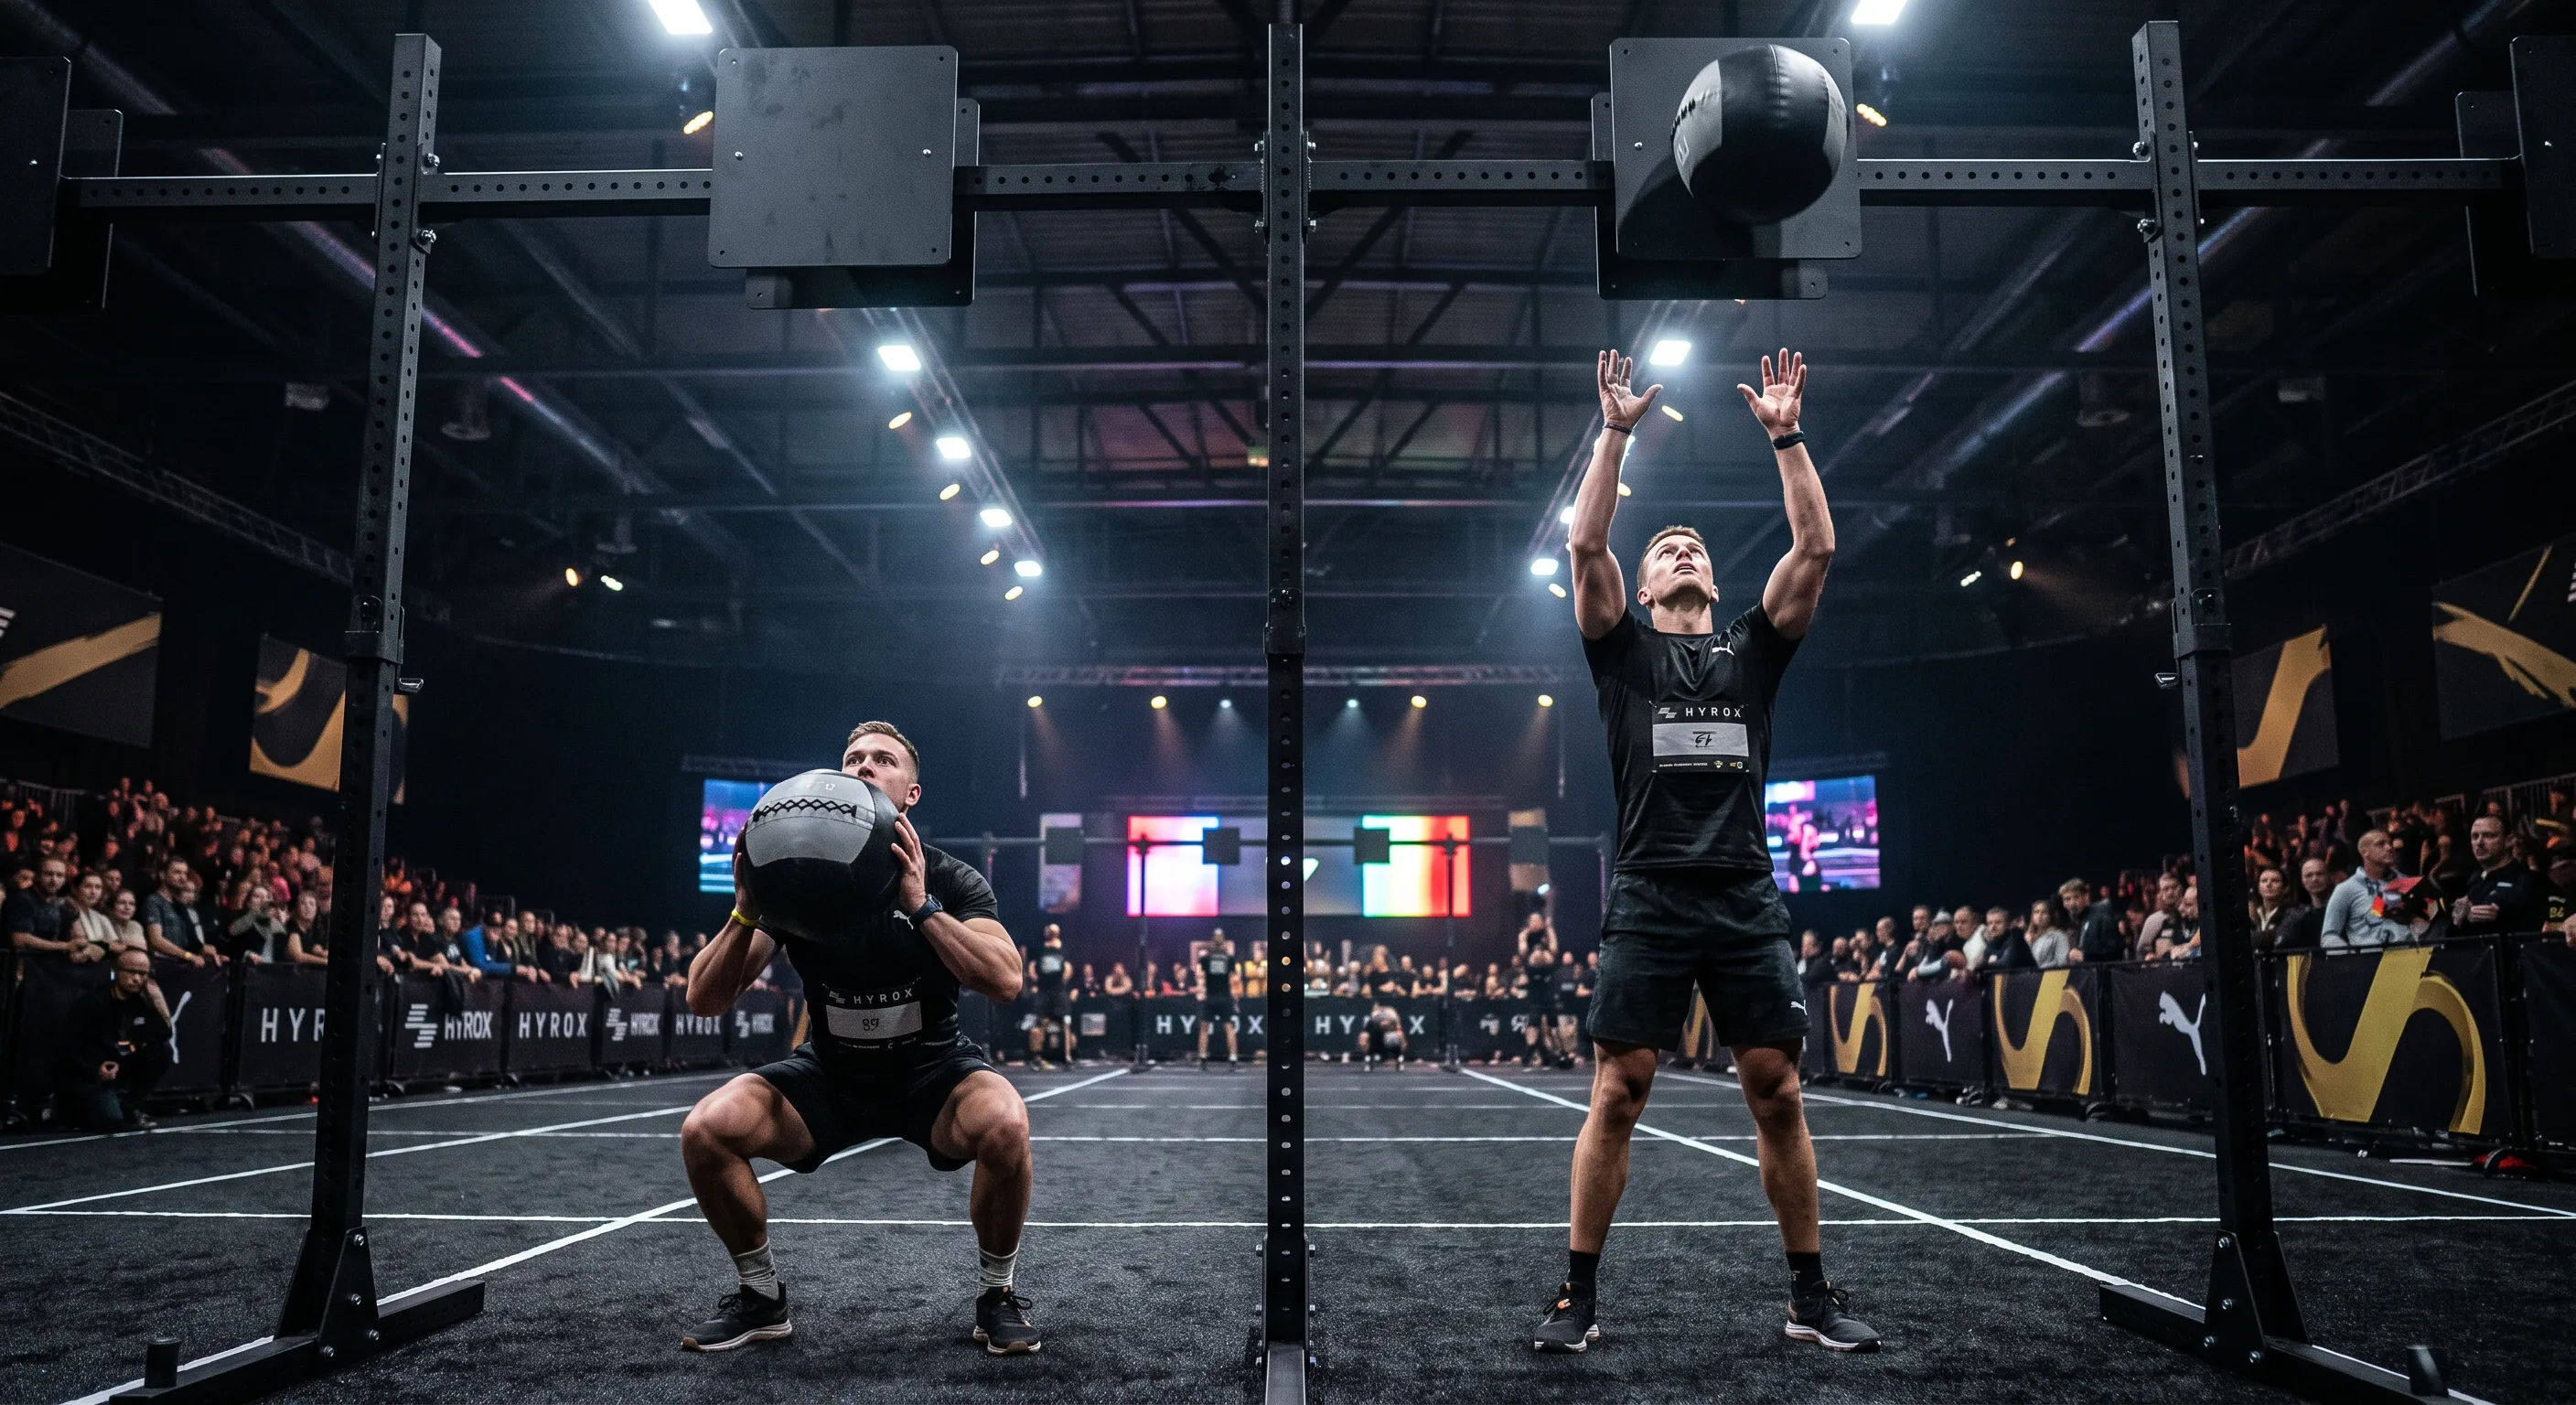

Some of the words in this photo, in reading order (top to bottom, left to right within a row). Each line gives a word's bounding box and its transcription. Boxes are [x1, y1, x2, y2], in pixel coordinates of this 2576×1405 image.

[1685, 707, 1741, 717] HYROX
[853, 988, 913, 1004] HYROX
[519, 1012, 588, 1039] HYROX
